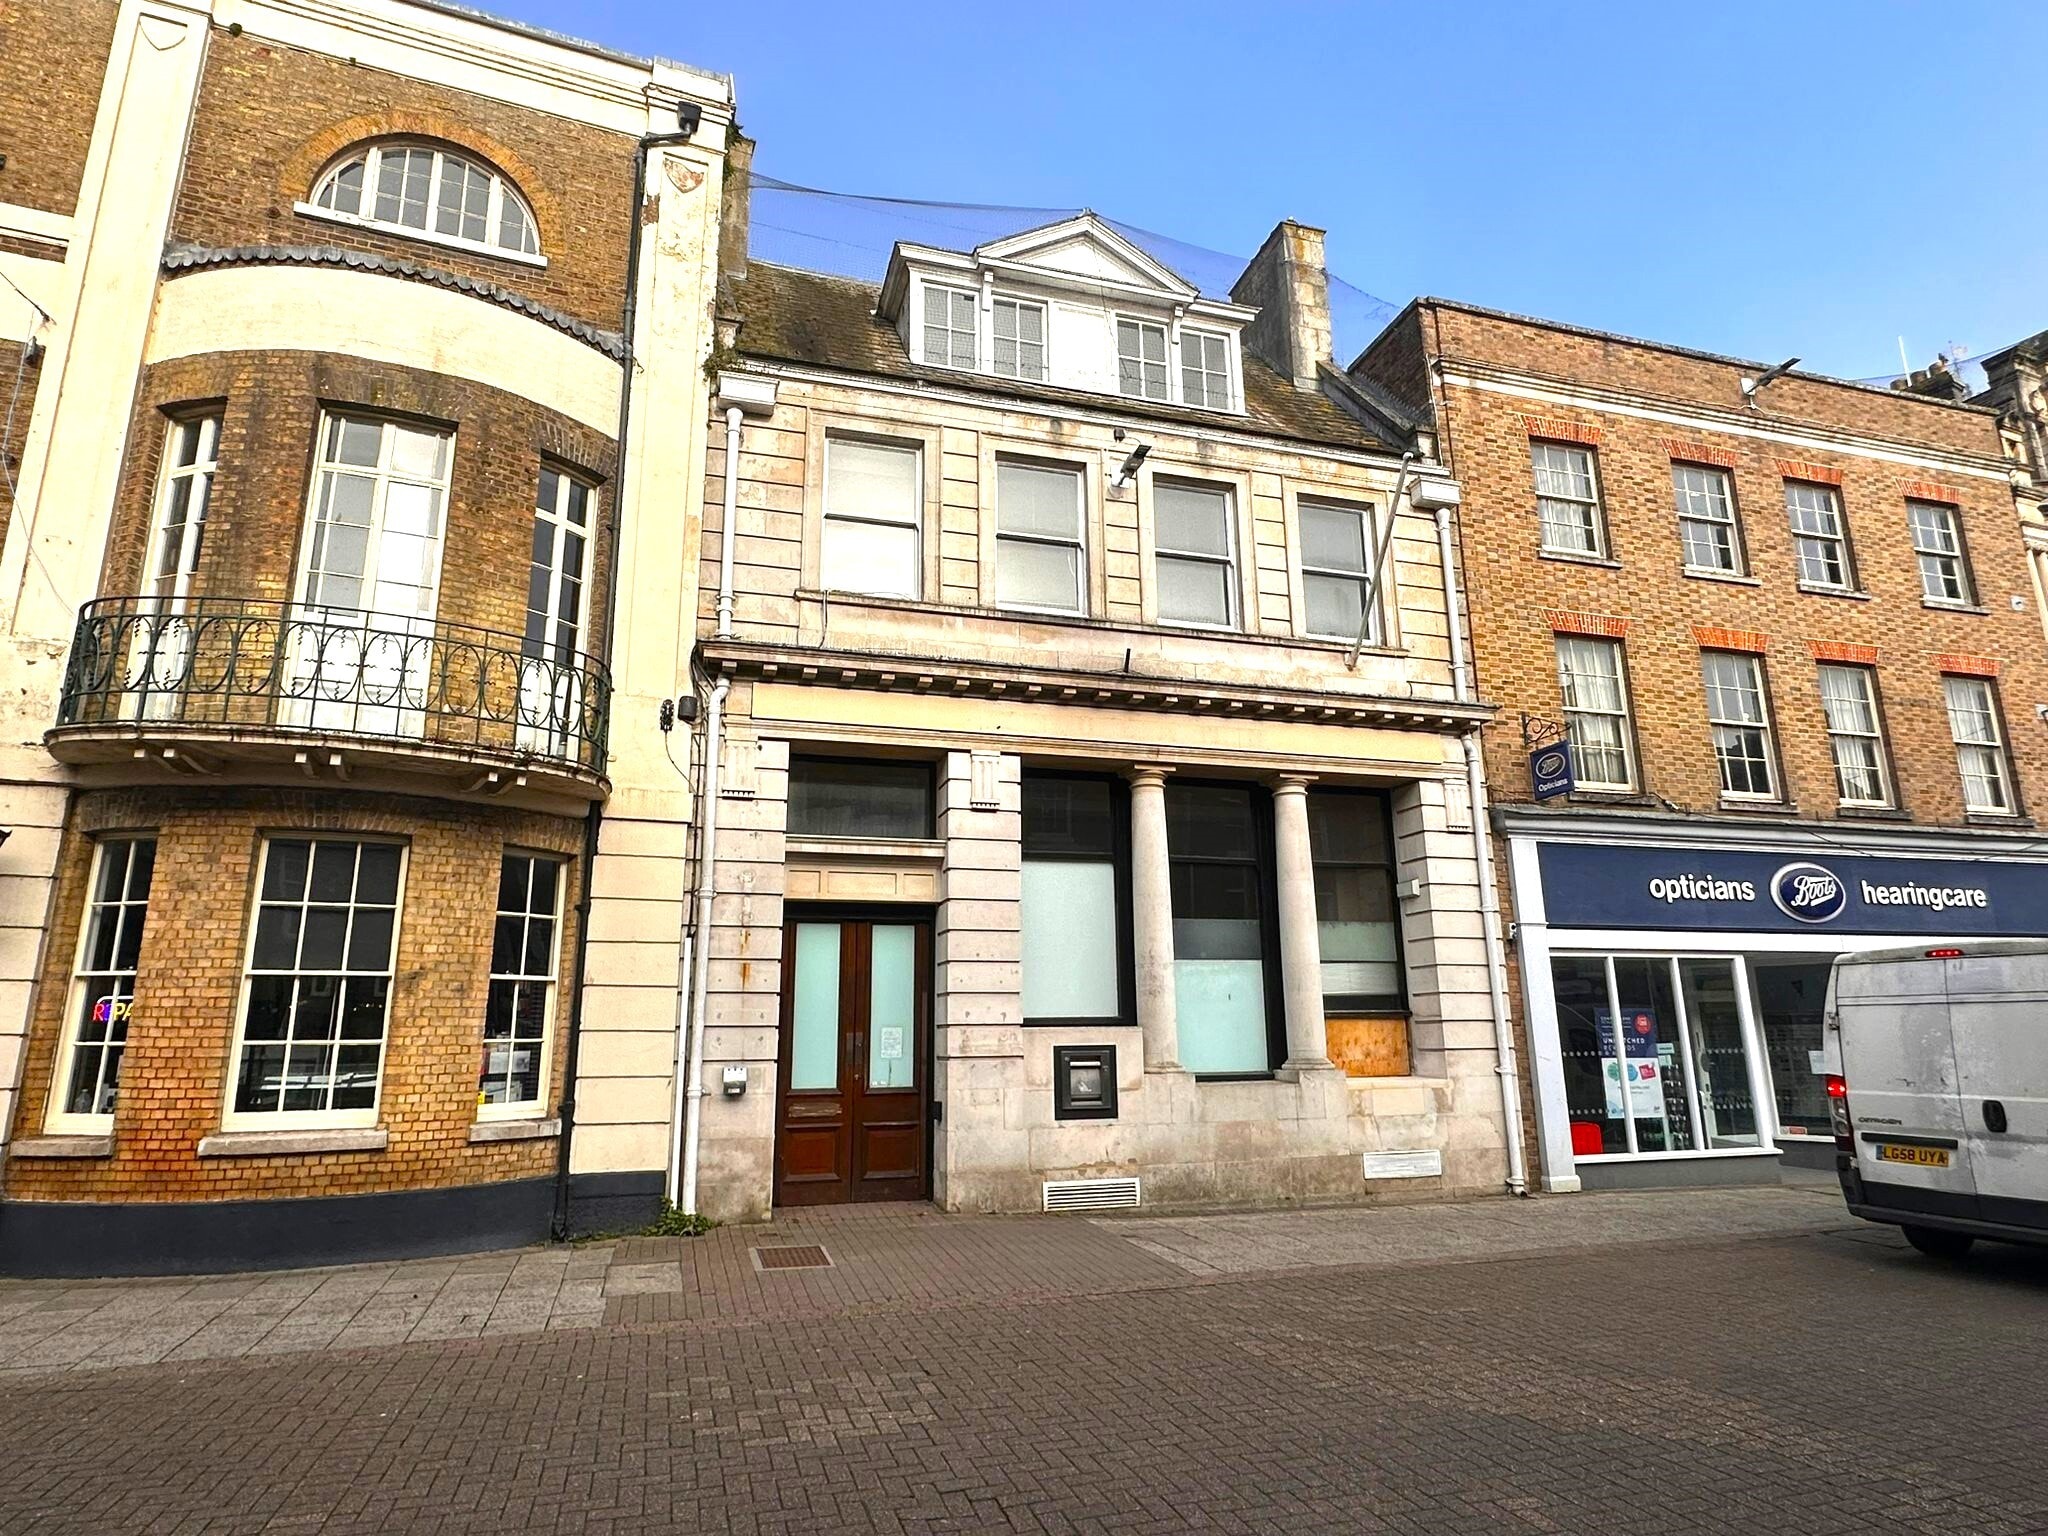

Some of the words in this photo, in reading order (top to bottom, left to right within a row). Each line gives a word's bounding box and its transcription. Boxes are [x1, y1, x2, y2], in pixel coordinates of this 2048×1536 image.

[1650, 873, 1755, 903] opticians
[1791, 875, 1837, 907] Boots
[1861, 879, 1987, 911] hearingcare
[1883, 1146, 1915, 1161] LG58
[1919, 1150, 1945, 1164] UYA
